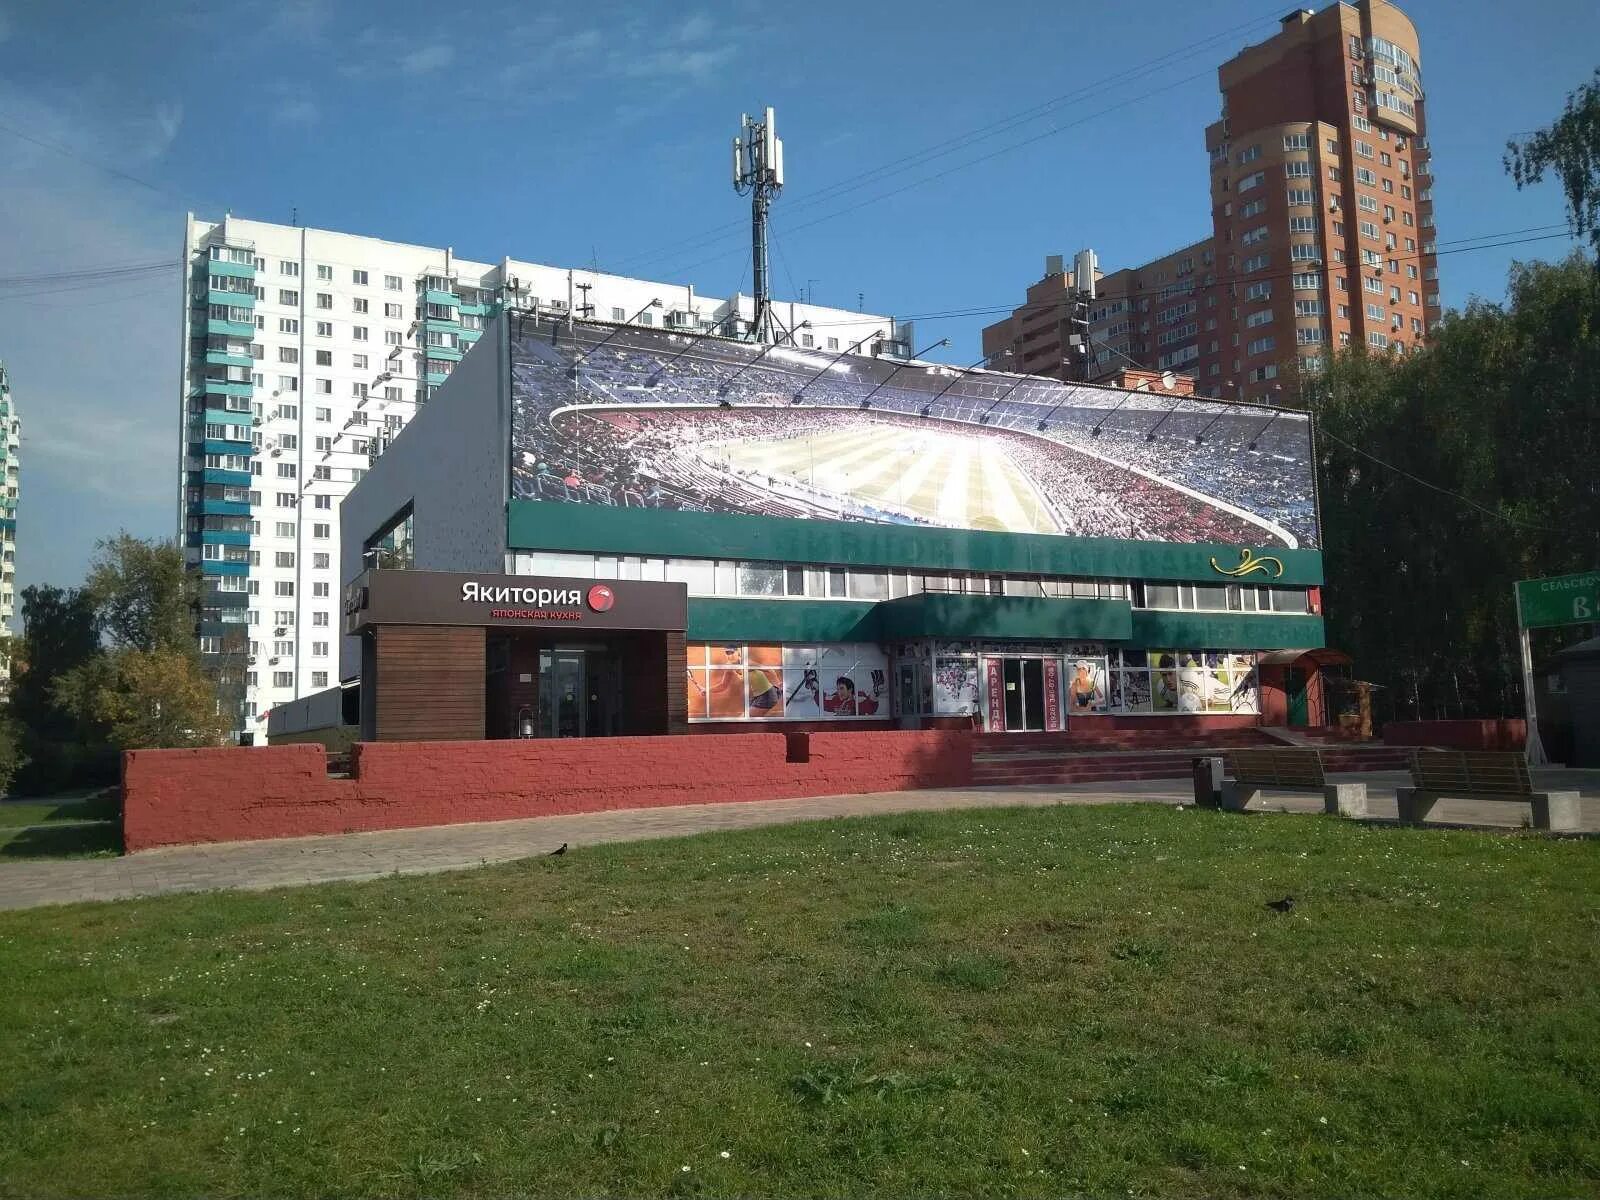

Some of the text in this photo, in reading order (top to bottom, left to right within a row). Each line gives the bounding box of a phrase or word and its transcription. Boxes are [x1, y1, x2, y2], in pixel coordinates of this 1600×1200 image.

[462, 582, 581, 607] Якитория
[492, 609, 582, 620] ЯПОНСКАЯ КУХНЯ
[991, 666, 1001, 730] АРЕНДА
